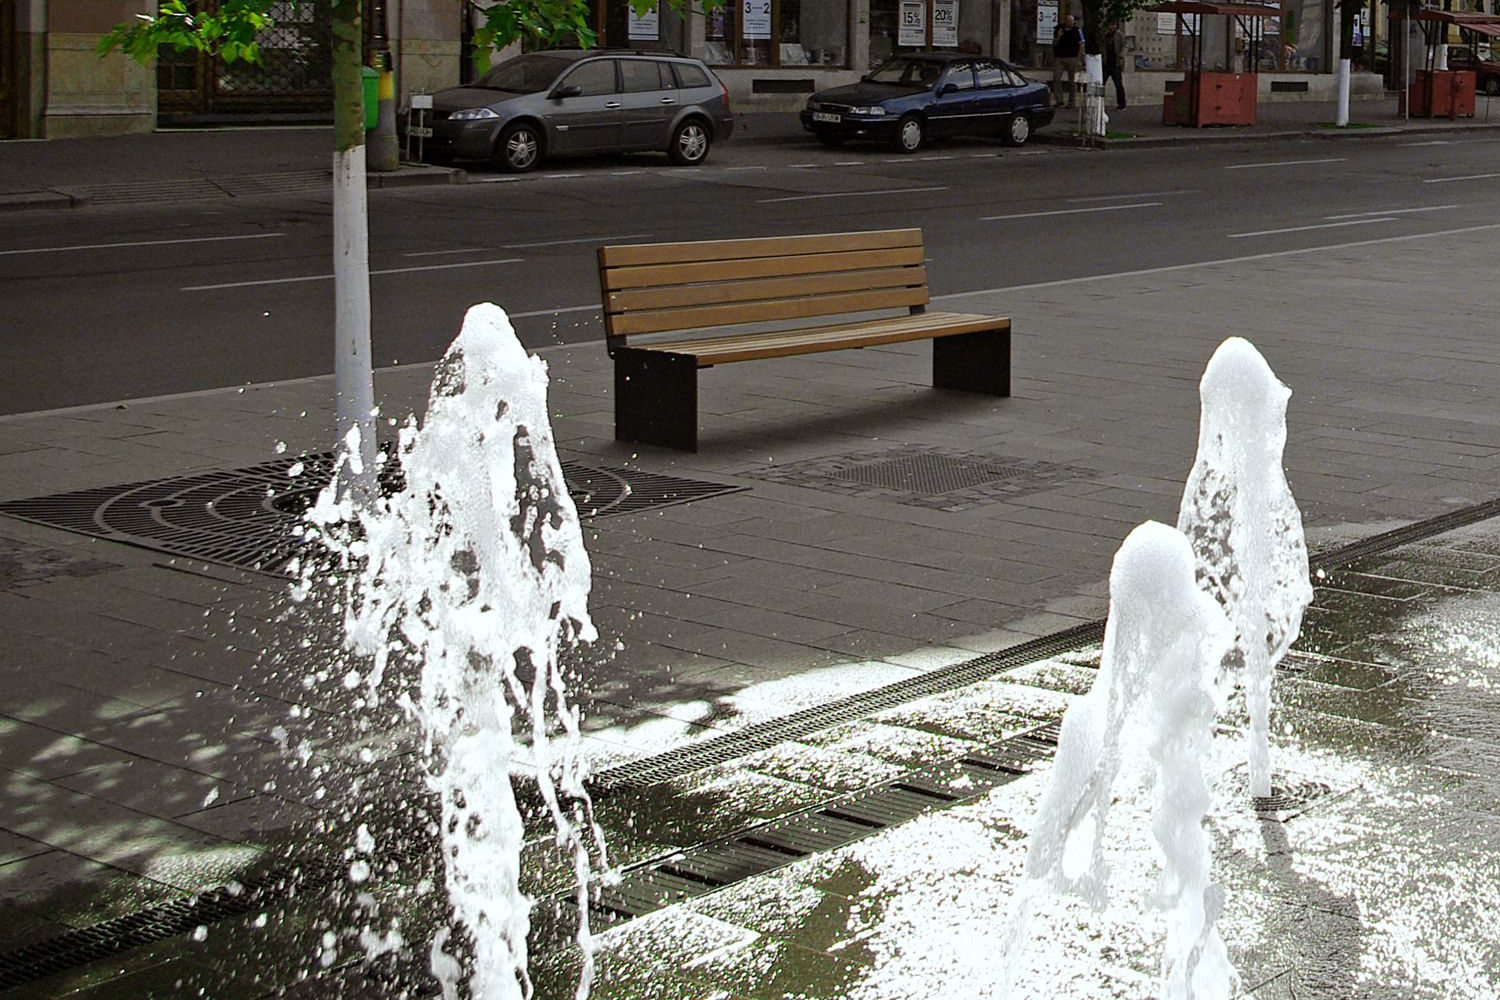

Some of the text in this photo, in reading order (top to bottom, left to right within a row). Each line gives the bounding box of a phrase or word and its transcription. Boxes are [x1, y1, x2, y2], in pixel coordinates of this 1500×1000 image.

[745, 1, 770, 14] 3 2
[903, 10, 921, 24] 15%
[934, 8, 953, 22] 20%
